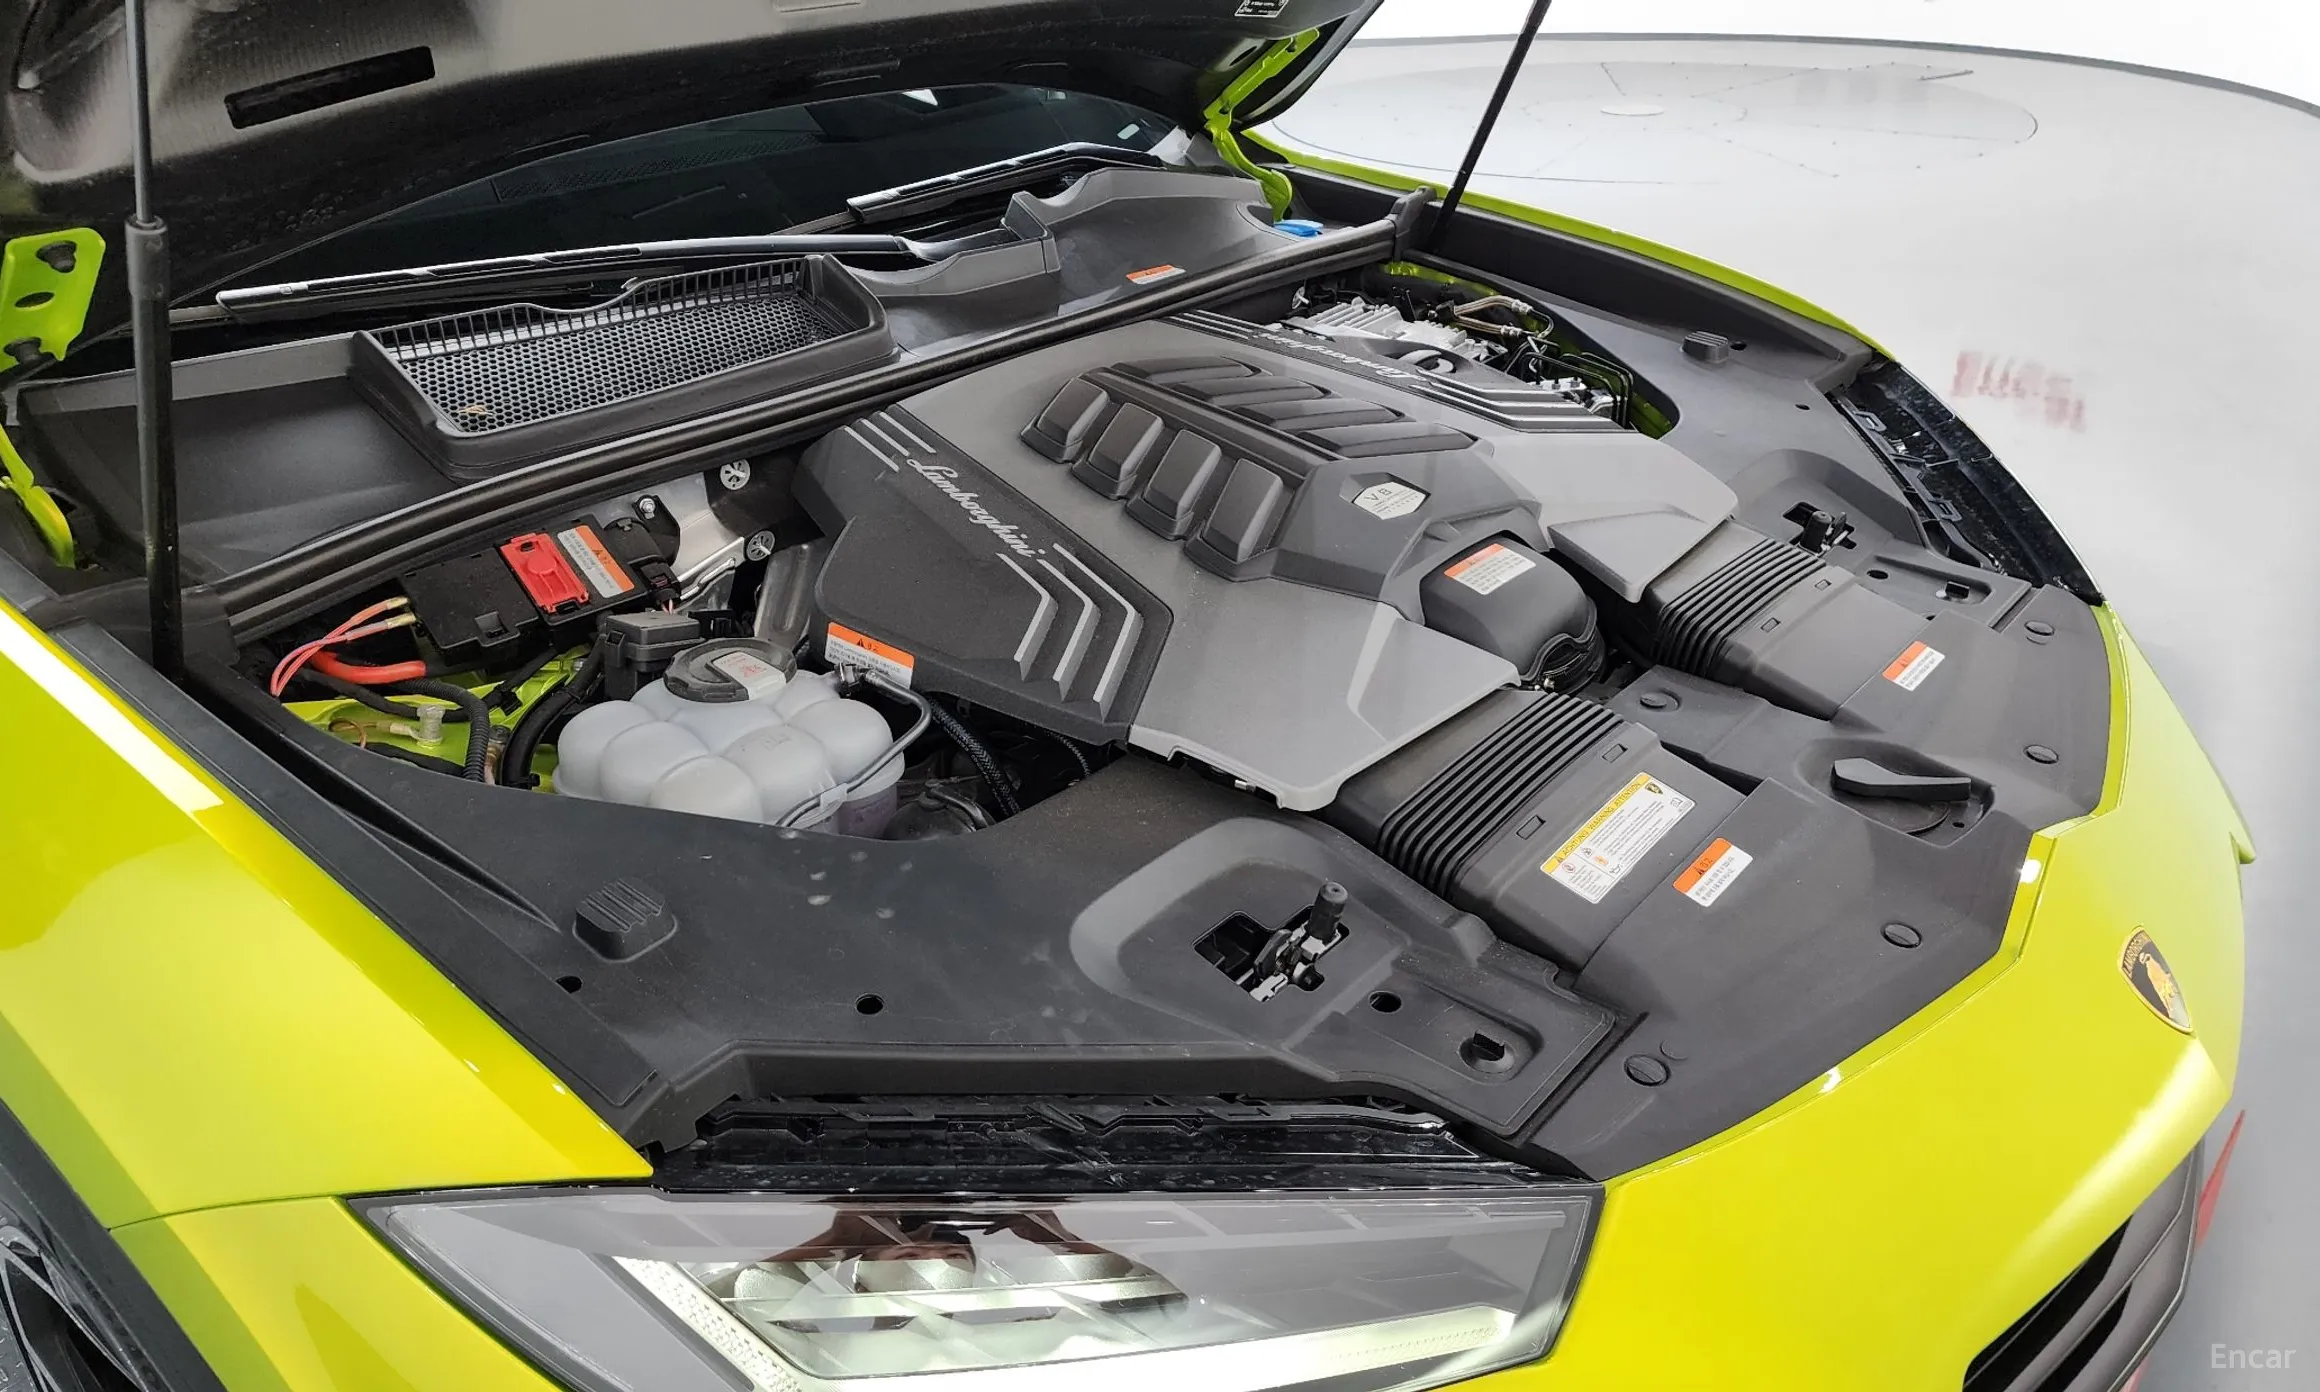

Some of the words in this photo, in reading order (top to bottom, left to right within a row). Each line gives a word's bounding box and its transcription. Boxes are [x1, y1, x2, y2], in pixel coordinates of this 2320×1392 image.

[906, 458, 1046, 557] Lamborghini
[1562, 830, 1590, 856] ACHTUNG
[1588, 806, 1614, 831] WARNING
